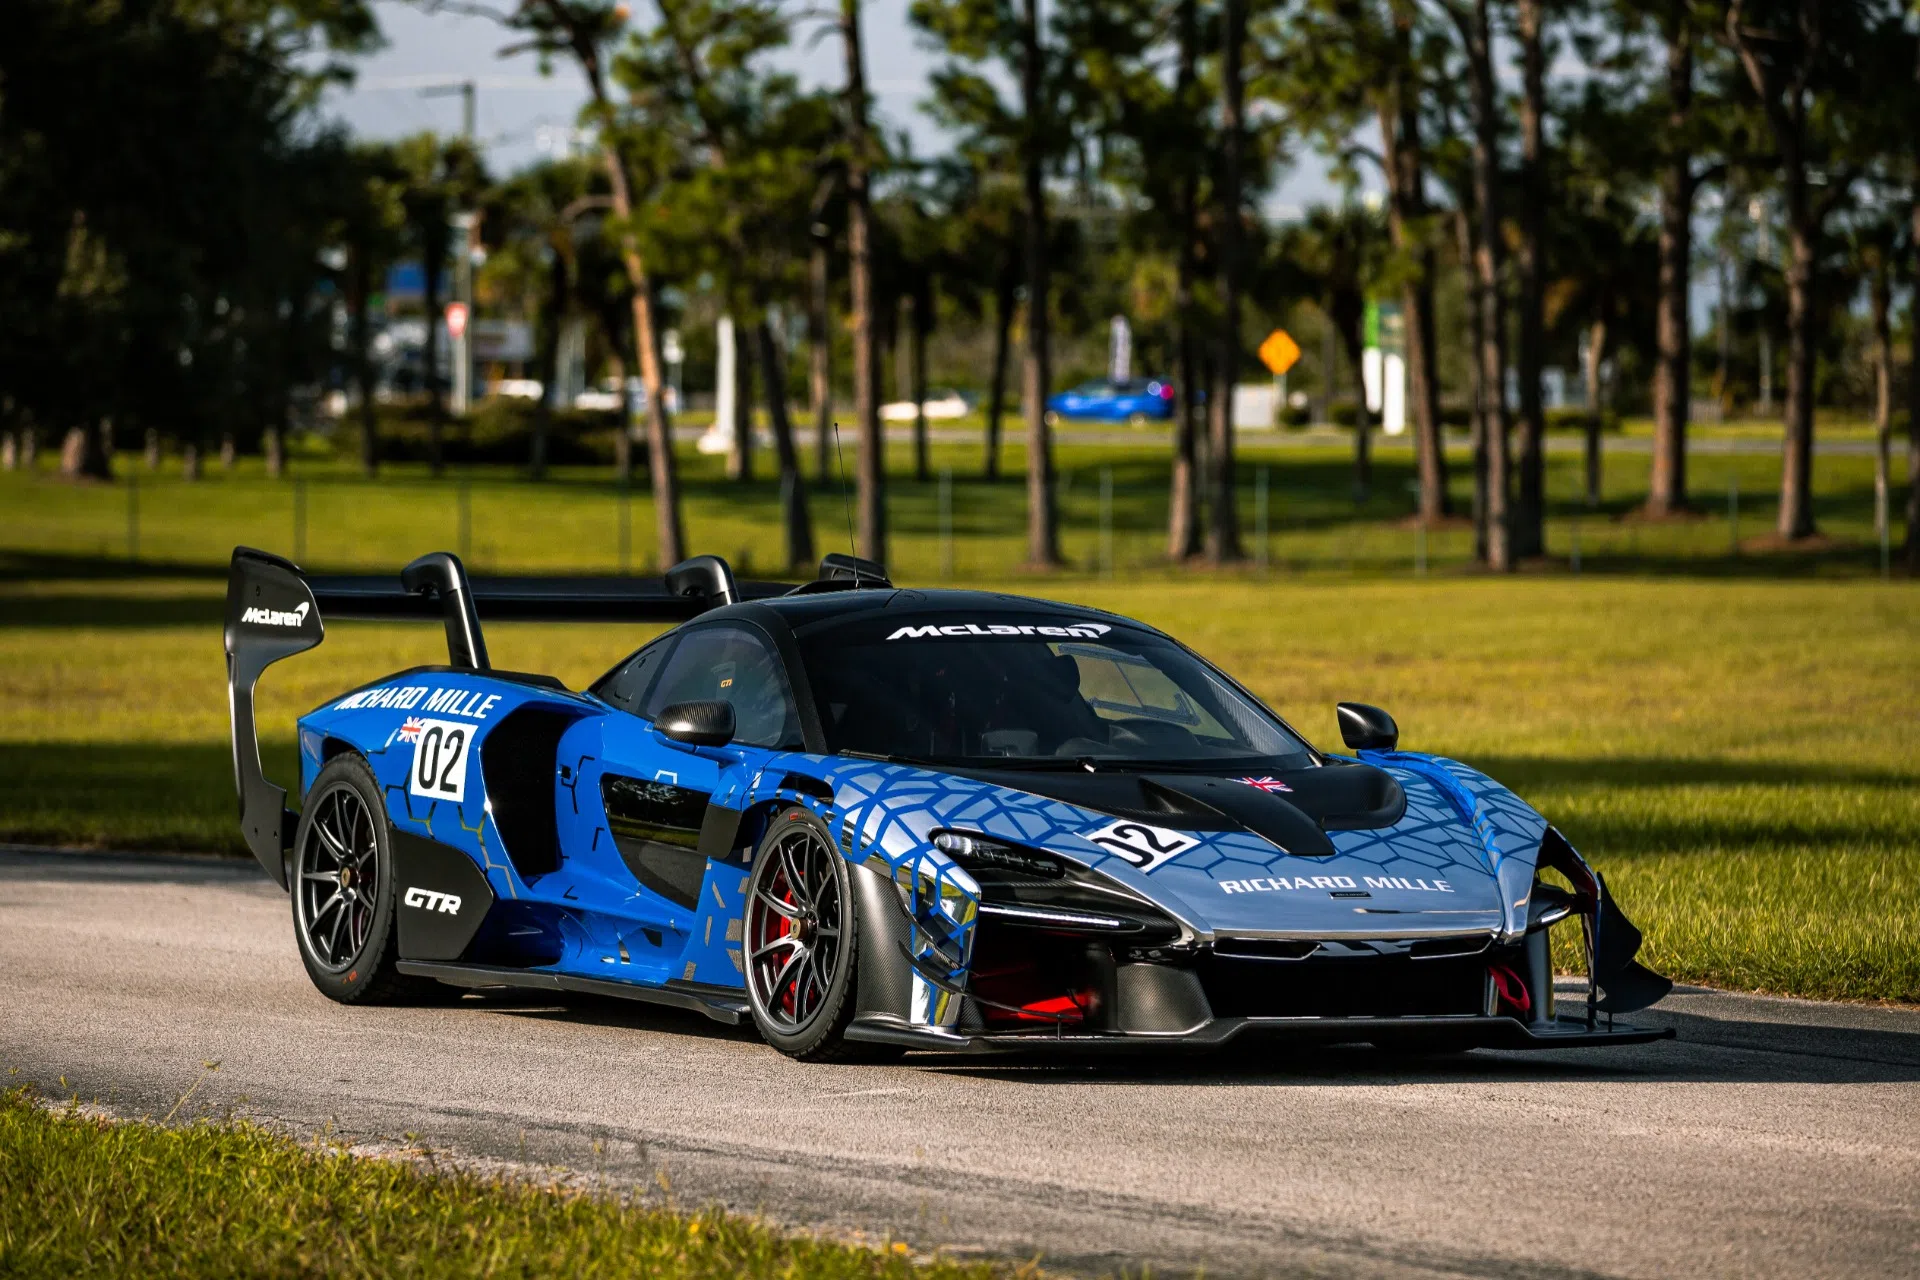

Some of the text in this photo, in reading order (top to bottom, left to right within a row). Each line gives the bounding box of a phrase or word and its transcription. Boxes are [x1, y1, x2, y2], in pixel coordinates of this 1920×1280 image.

[242, 603, 307, 626] McLaren
[886, 624, 1109, 640] McLaren
[334, 686, 502, 719] RICHARD MILLE
[417, 726, 465, 794] 02
[1091, 824, 1187, 868] 02
[1219, 876, 1456, 894] RICHARD MILLE
[404, 886, 462, 915] GTR
